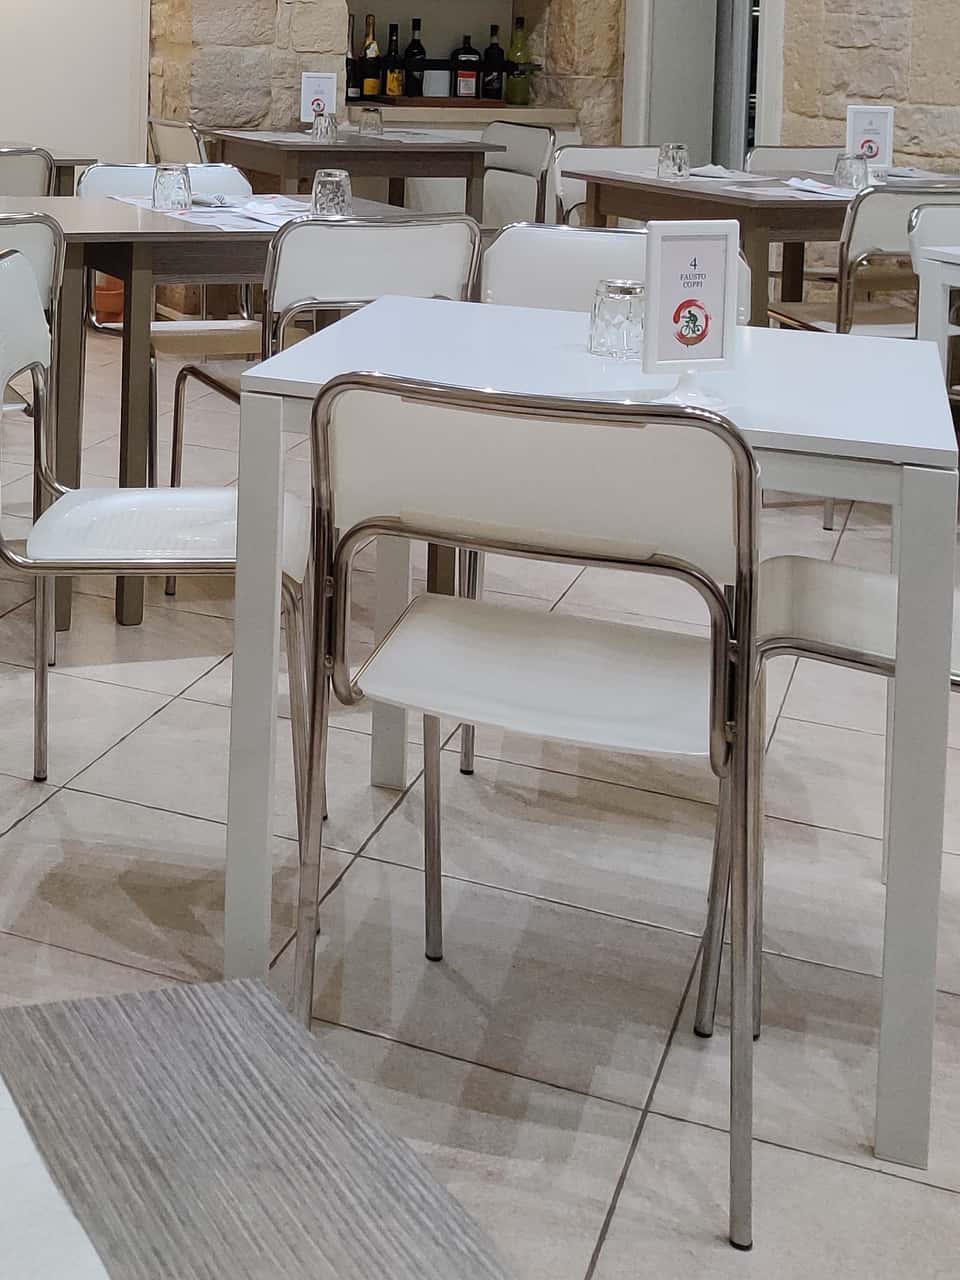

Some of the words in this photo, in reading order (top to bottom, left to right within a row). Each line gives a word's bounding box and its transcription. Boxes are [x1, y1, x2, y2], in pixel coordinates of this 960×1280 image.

[689, 256, 698, 271] 4
[680, 272, 707, 281] FAUSTO
[682, 280, 704, 289] COPPI
